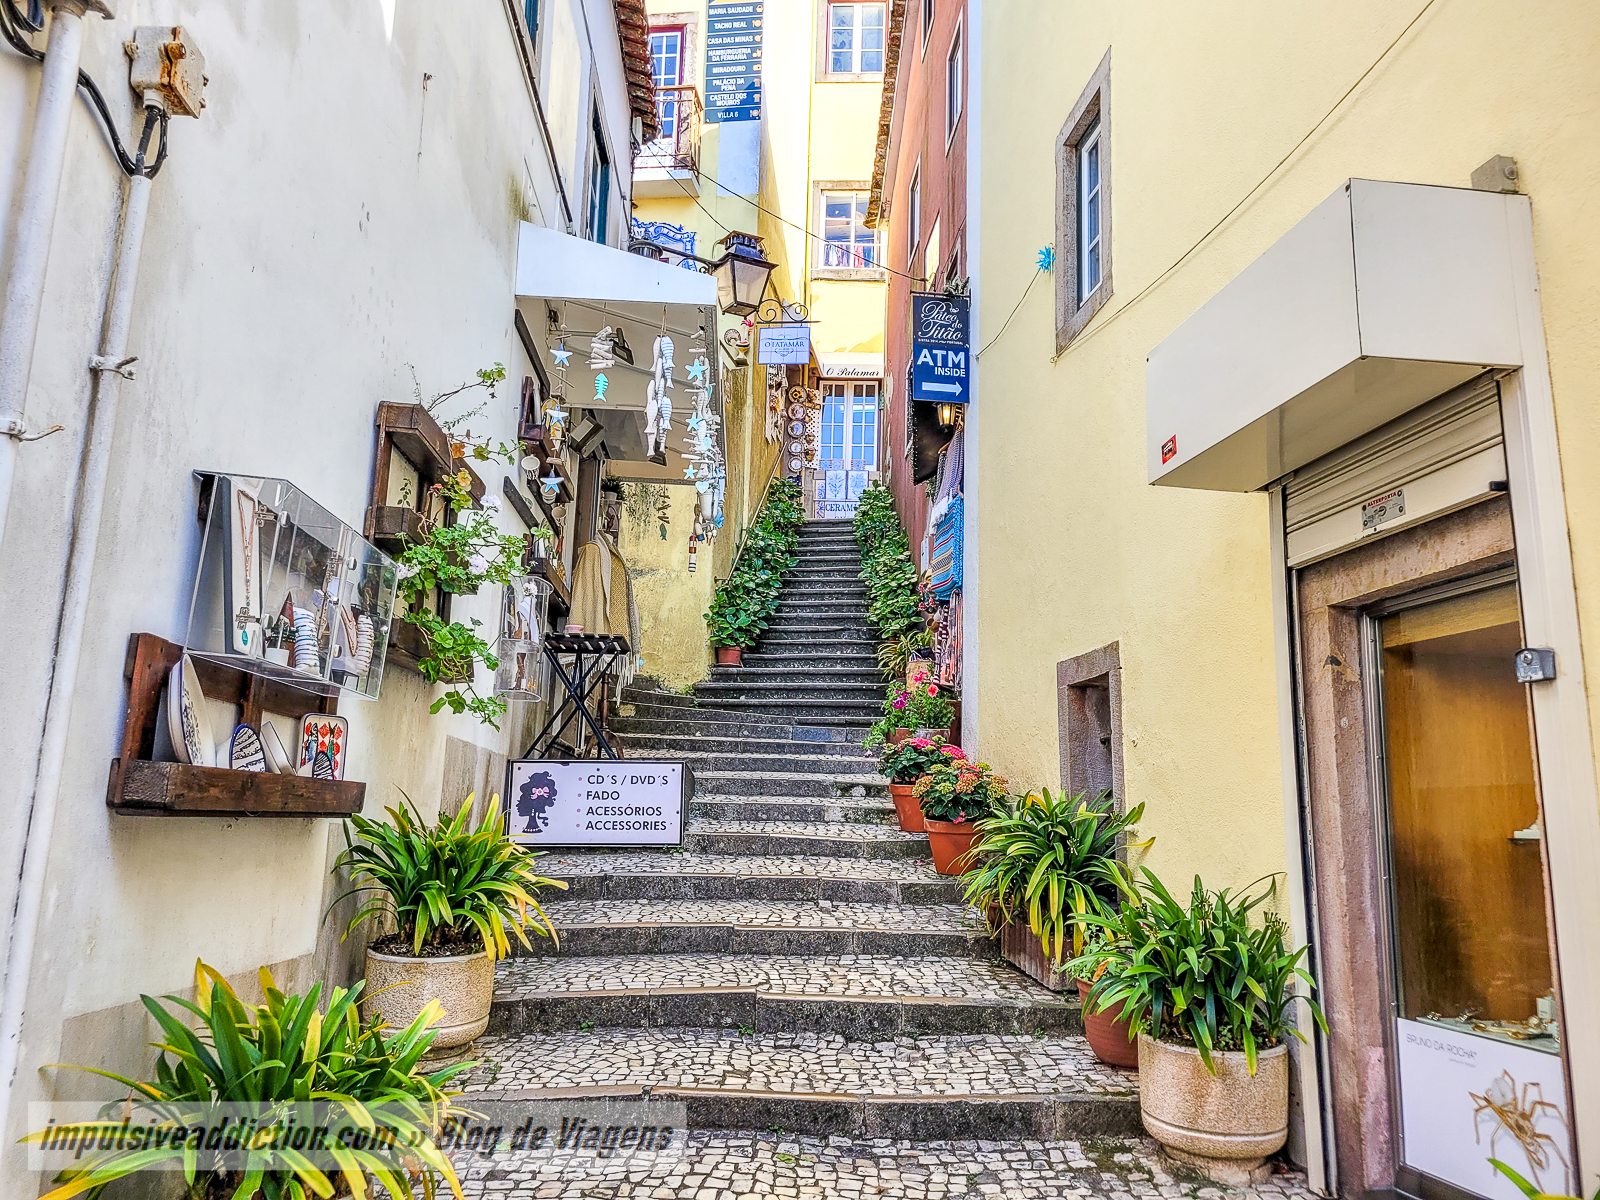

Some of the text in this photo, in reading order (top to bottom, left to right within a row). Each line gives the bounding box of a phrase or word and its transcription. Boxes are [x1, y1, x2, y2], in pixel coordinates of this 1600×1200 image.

[727, 6, 754, 14] SAUDADE
[734, 35, 753, 43] MINAS
[712, 65, 746, 74] MIRADOURO
[952, 319, 963, 329] do
[918, 318, 963, 341] Titão
[916, 348, 966, 368] ATM
[826, 366, 880, 376] O Patamar
[934, 366, 966, 378] INSIDE
[586, 790, 620, 800] FADO
[586, 804, 662, 816] ACESSÓRIOS
[586, 820, 667, 830] ACCESSORIES
[1434, 1040, 1445, 1052] DA
